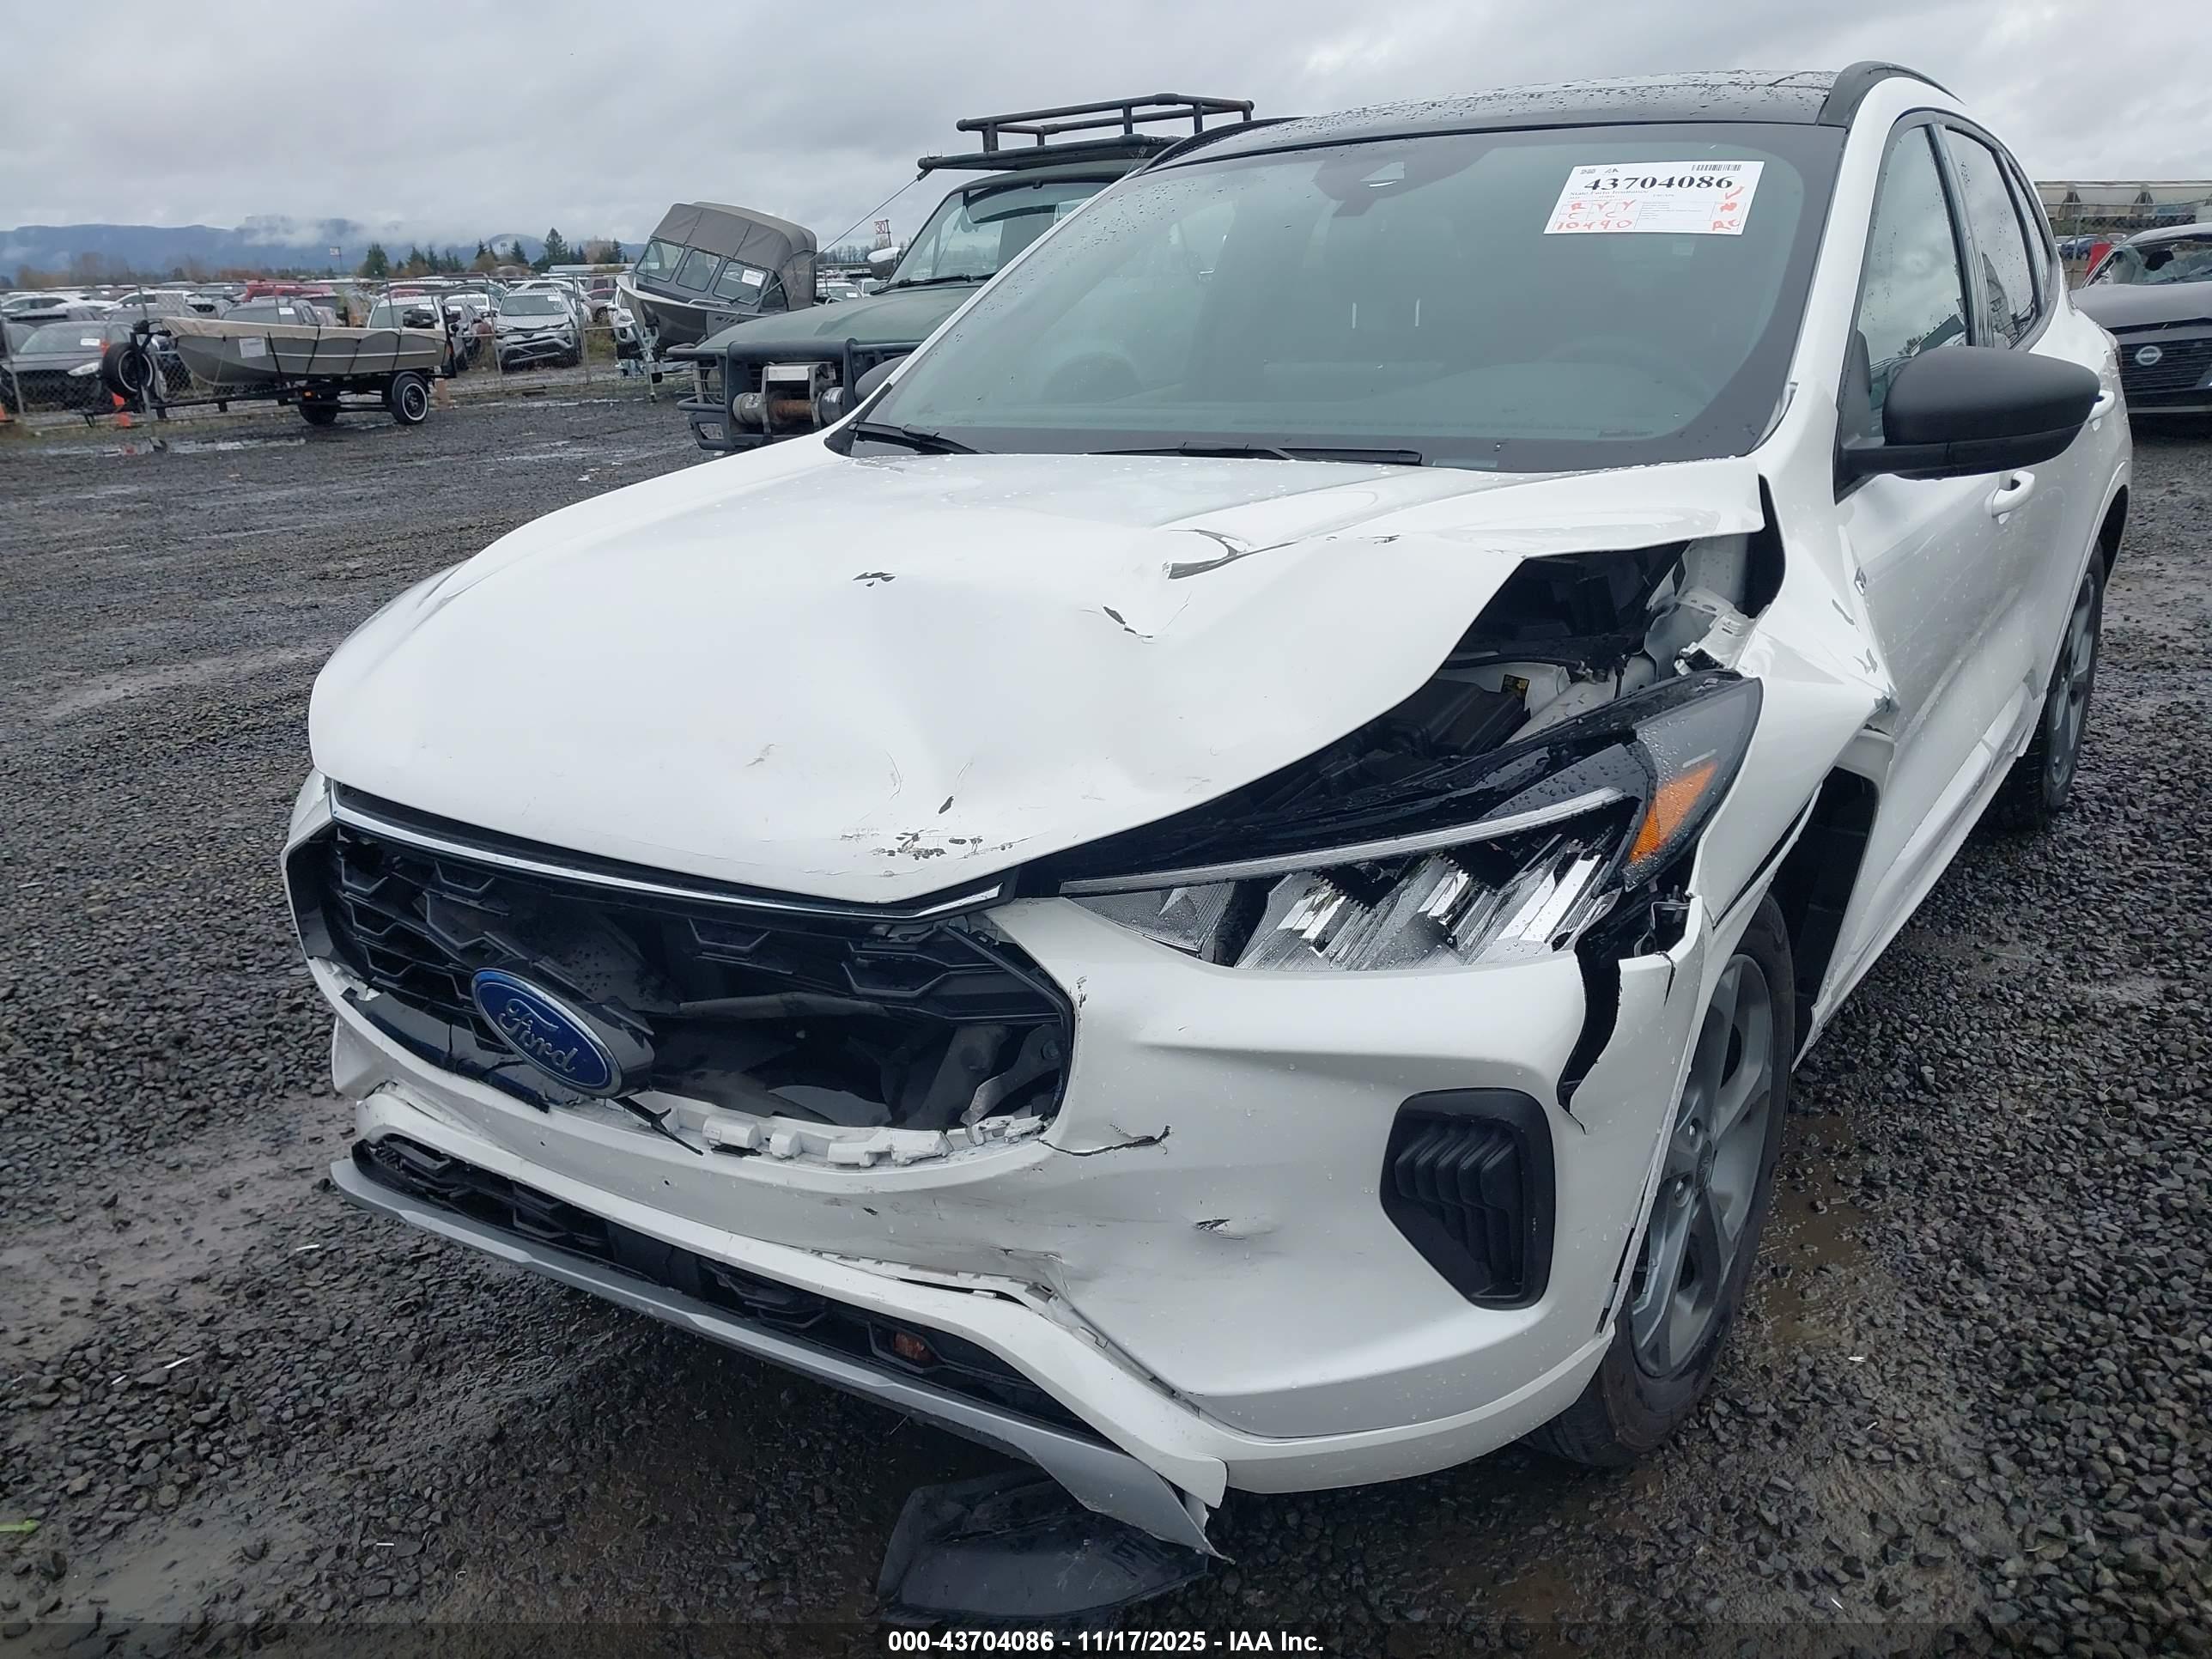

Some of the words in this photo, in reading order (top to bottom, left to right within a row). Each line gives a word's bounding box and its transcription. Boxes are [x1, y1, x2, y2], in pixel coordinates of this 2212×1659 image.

[1584, 175, 1733, 191] 43704086
[876, 222, 885, 234] 30
[499, 998, 579, 1073] Ford
